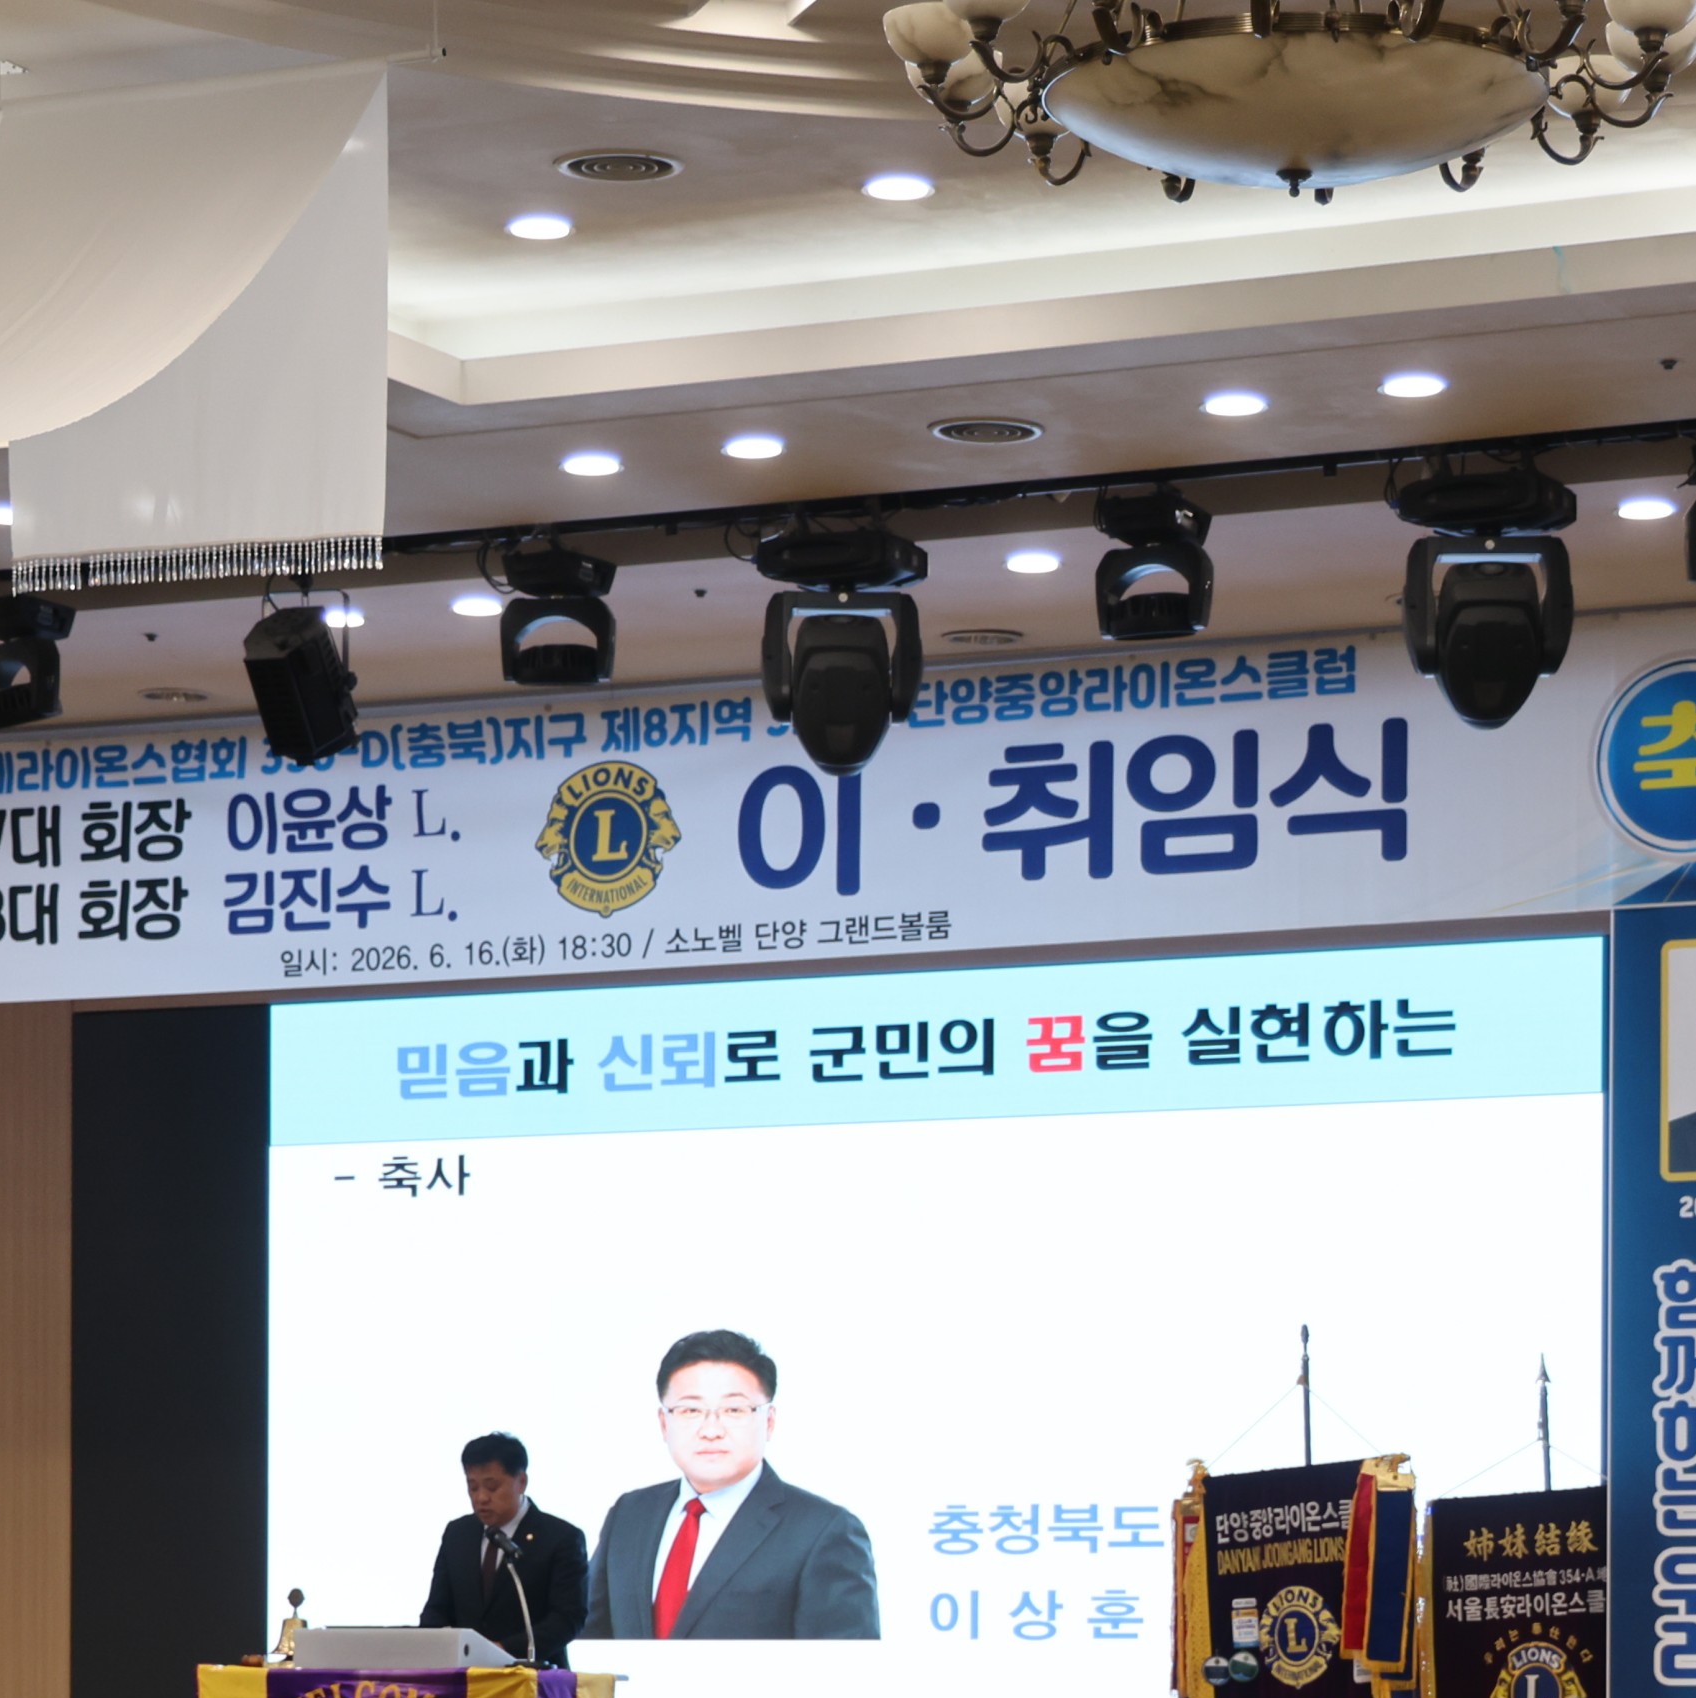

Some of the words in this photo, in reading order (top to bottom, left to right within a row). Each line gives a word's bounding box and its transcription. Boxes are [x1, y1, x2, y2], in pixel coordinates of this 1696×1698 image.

[600, 697, 752, 753] 제8지역
[908, 645, 1356, 728] 단양중앙라이온스클럽
[566, 766, 650, 800] LIONS
[80, 798, 192, 863] 회장
[227, 784, 392, 854] 이윤상
[591, 809, 628, 862] L
[78, 876, 189, 941] 회장
[223, 864, 391, 936] 김진수
[566, 874, 648, 905] INTERNATIONAL
[280, 947, 338, 978] 일시:
[350, 945, 419, 973] 2026.
[429, 943, 451, 970] 6.
[558, 932, 633, 962] 18:30
[664, 923, 743, 954] 소노벨
[754, 919, 807, 951] 단양
[817, 910, 953, 946] 그랜드볼룸
[396, 1038, 574, 1100] 믿음과
[598, 1030, 781, 1093] 신뢰로
[809, 1017, 995, 1083] 군민의
[1025, 1011, 1153, 1074] 꿈을
[1181, 998, 1457, 1067] 실현하는
[378, 1154, 471, 1197] 축사
[928, 1503, 1165, 1555] 충청북도
[929, 1590, 979, 1640] 이
[1008, 1590, 1064, 1641] 상
[1087, 1590, 1144, 1639] 훈
[1272, 1588, 1319, 1611] LIONS
[1284, 1618, 1307, 1653] L
[1511, 1647, 1561, 1669] LIONS
